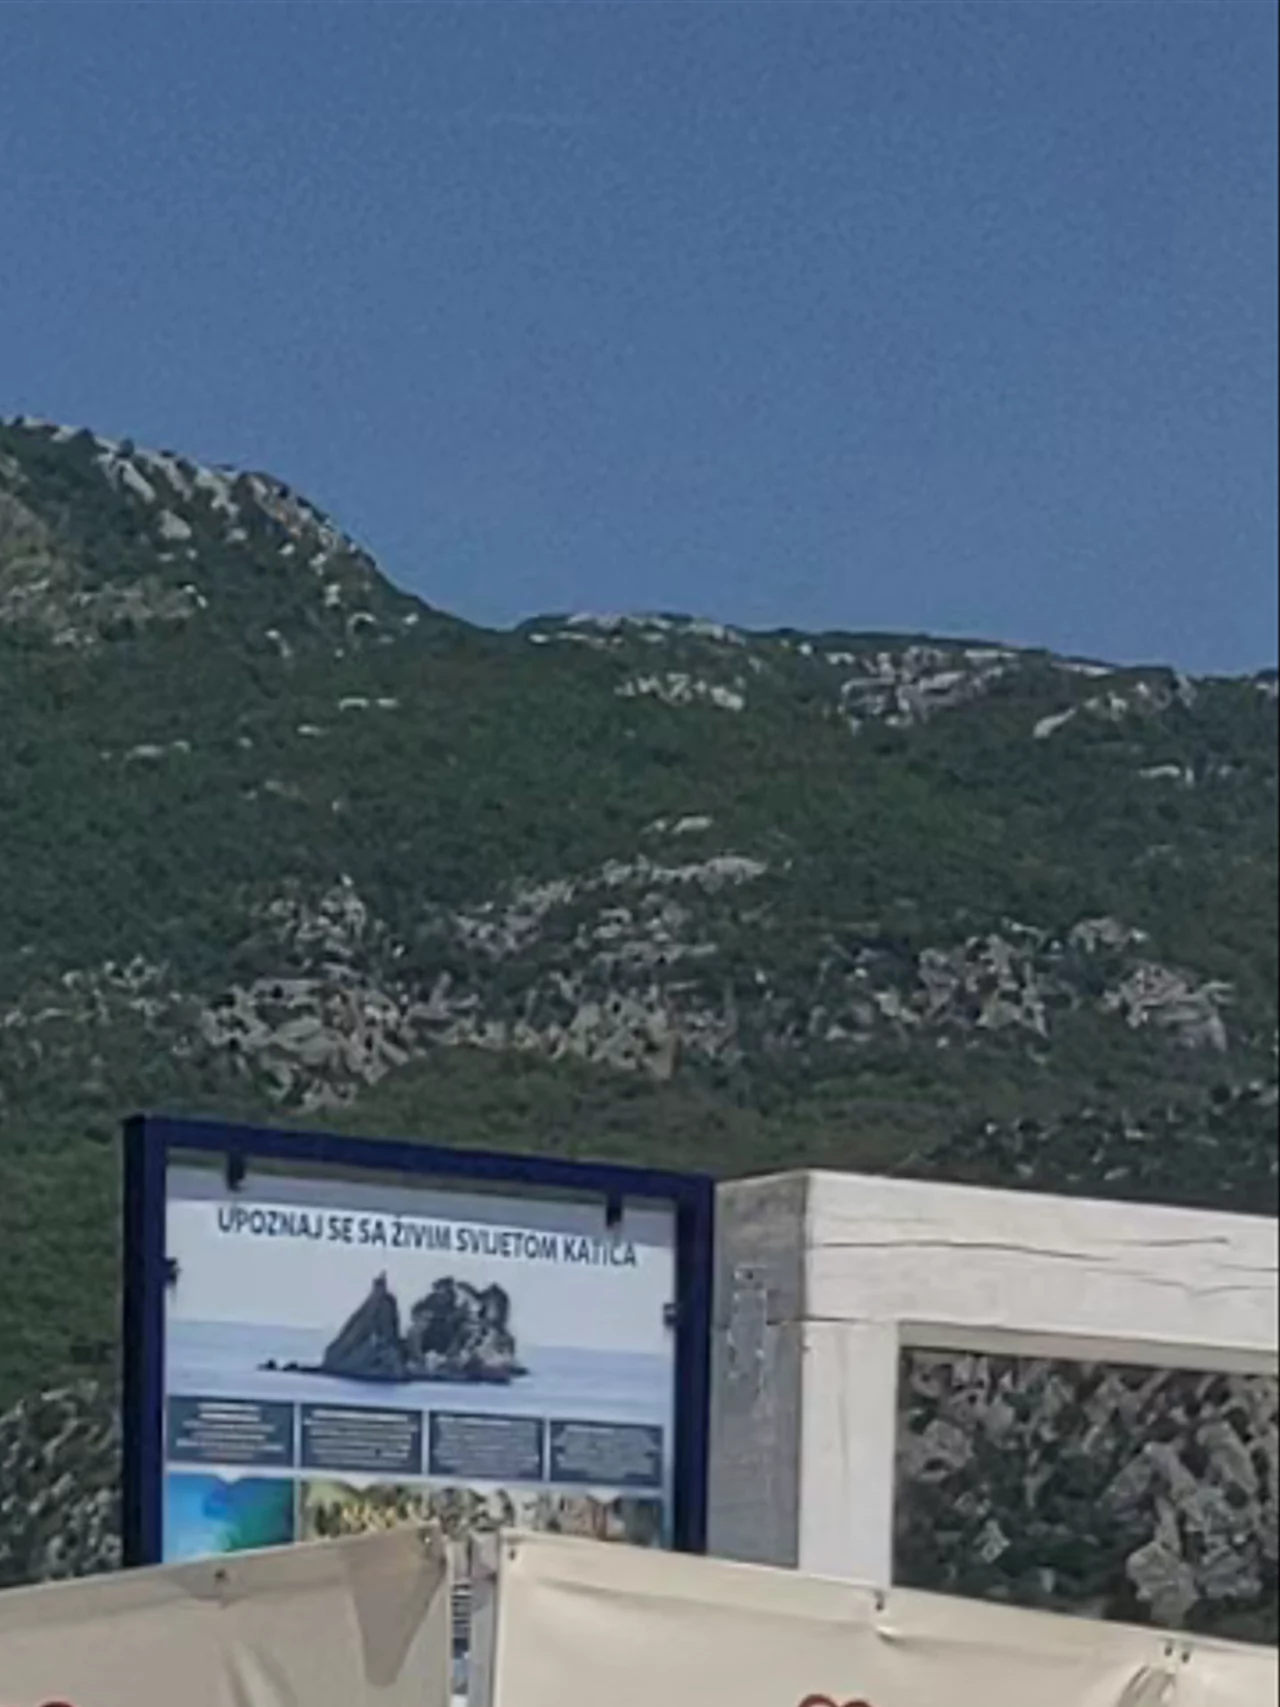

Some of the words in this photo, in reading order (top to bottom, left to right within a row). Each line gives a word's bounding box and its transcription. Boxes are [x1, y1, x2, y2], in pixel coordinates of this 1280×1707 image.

[218, 1207, 323, 1240] UPOZNAJ
[328, 1215, 353, 1244] SE
[358, 1217, 386, 1247] SA
[456, 1227, 557, 1261] SVIJETOM
